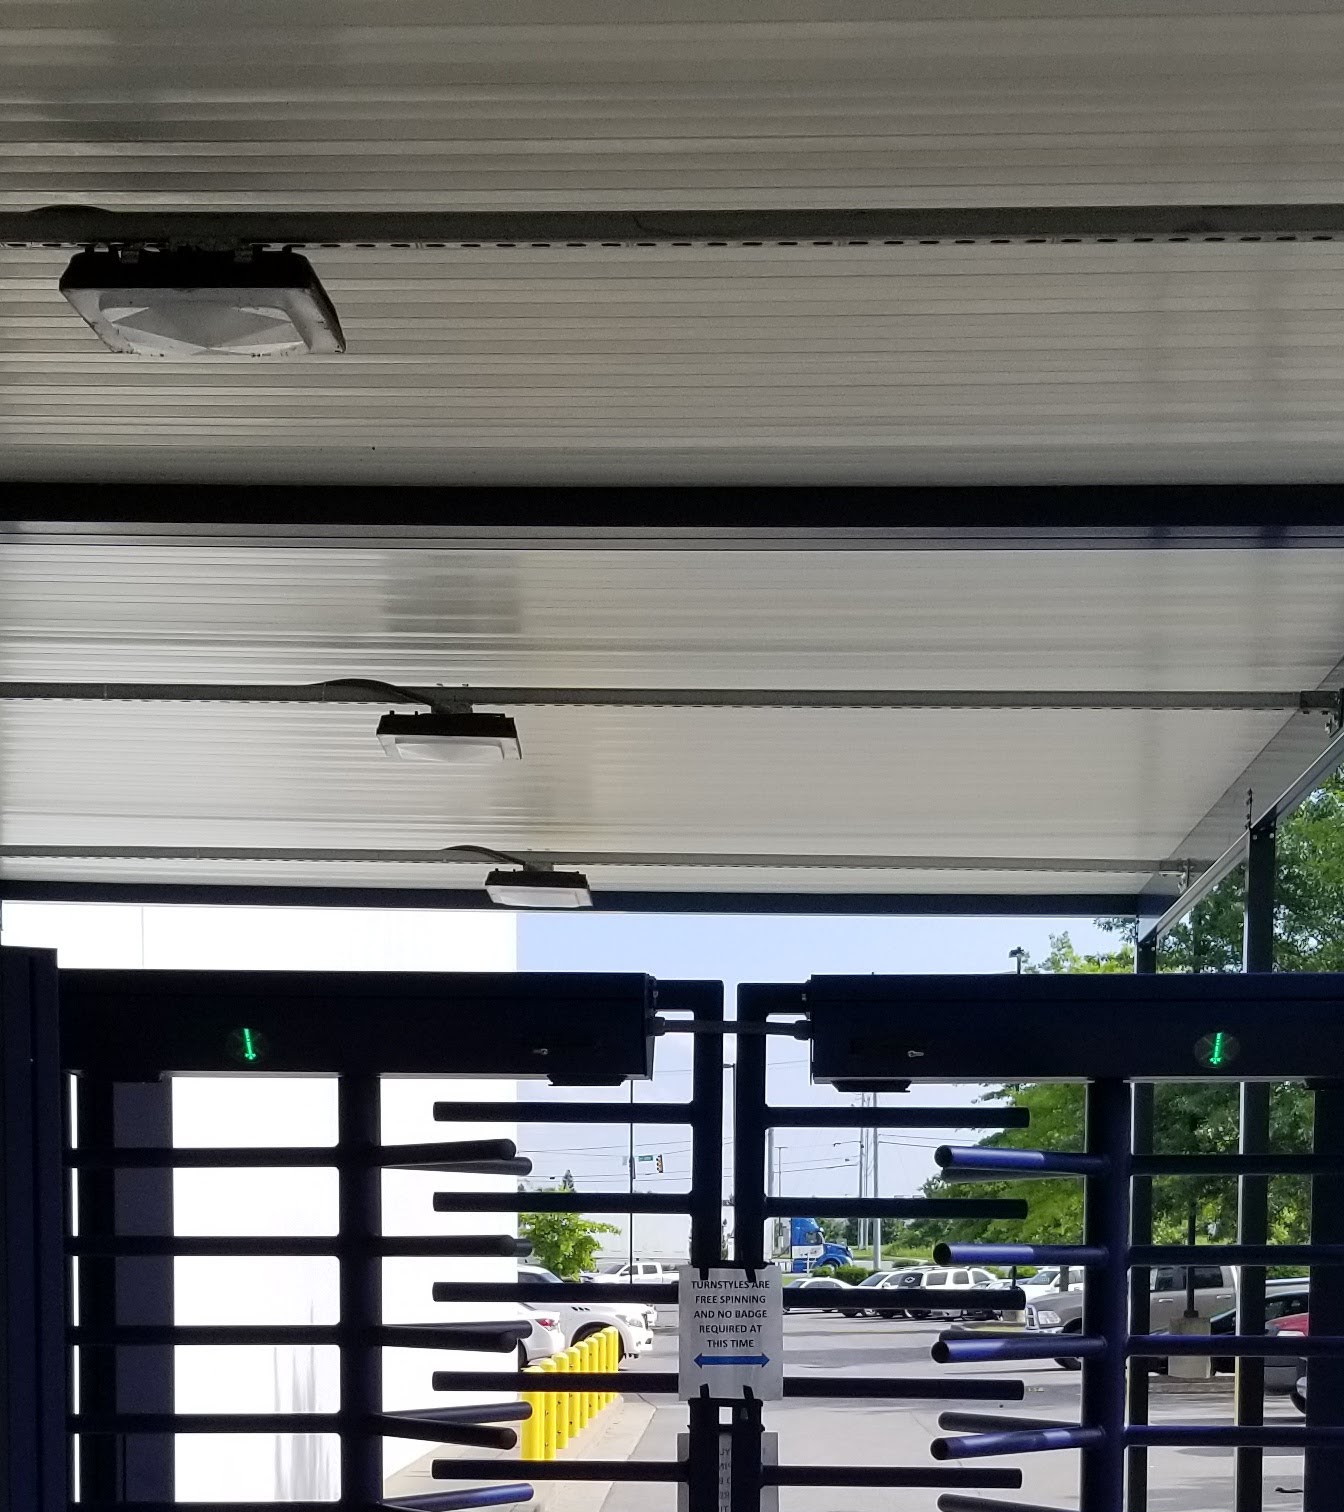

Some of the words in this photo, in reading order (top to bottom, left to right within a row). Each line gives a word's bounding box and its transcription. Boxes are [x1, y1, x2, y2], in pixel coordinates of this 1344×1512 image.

[691, 1280, 750, 1289] TURNSTYLES
[751, 1280, 771, 1289] ARE
[695, 1295, 718, 1304] FREE
[719, 1295, 767, 1304] SPINNING
[693, 1310, 716, 1319] AND
[717, 1310, 733, 1319] NO
[735, 1310, 768, 1319] BADGE
[699, 1324, 748, 1334] REQUIRED
[749, 1324, 763, 1333] AT
[706, 1339, 729, 1348] THIS
[730, 1339, 755, 1348] TIME
